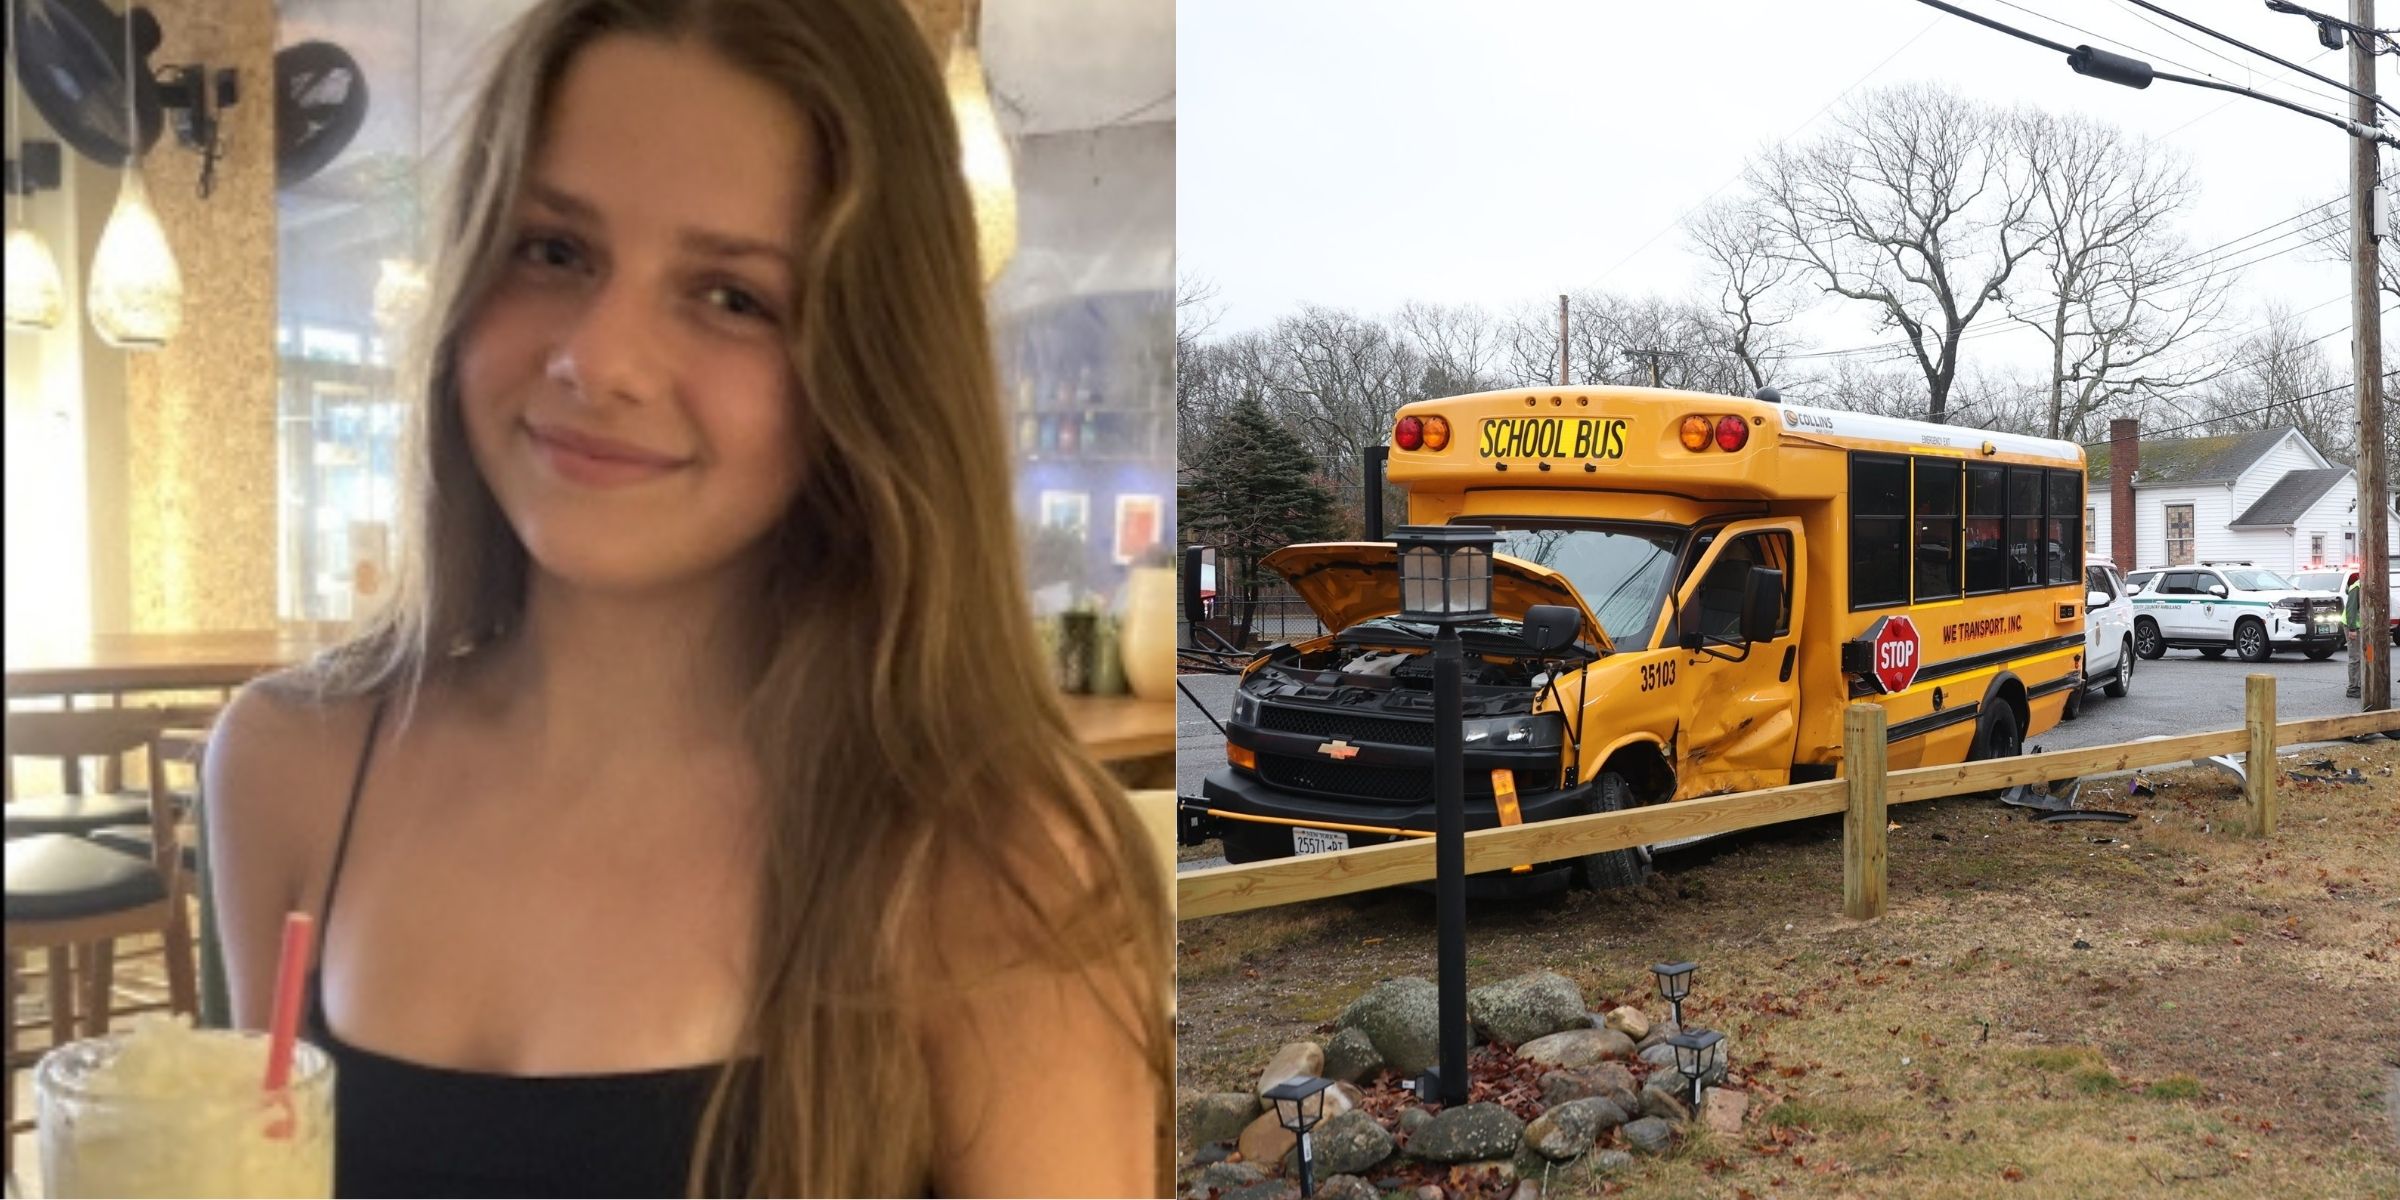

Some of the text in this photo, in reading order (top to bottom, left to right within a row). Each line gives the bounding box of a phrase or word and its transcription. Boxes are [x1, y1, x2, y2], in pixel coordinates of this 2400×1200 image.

[1798, 413, 1833, 428] COLLINS
[1480, 418, 1626, 459] SCHOOL BUS
[1921, 434, 1951, 446] EMERGENCY EXIT
[1942, 624, 1957, 644] WE
[2007, 614, 2023, 634] INC.
[1881, 640, 1914, 669] STOP
[1640, 659, 1676, 692] 35103
[1298, 836, 1325, 853] 25571
